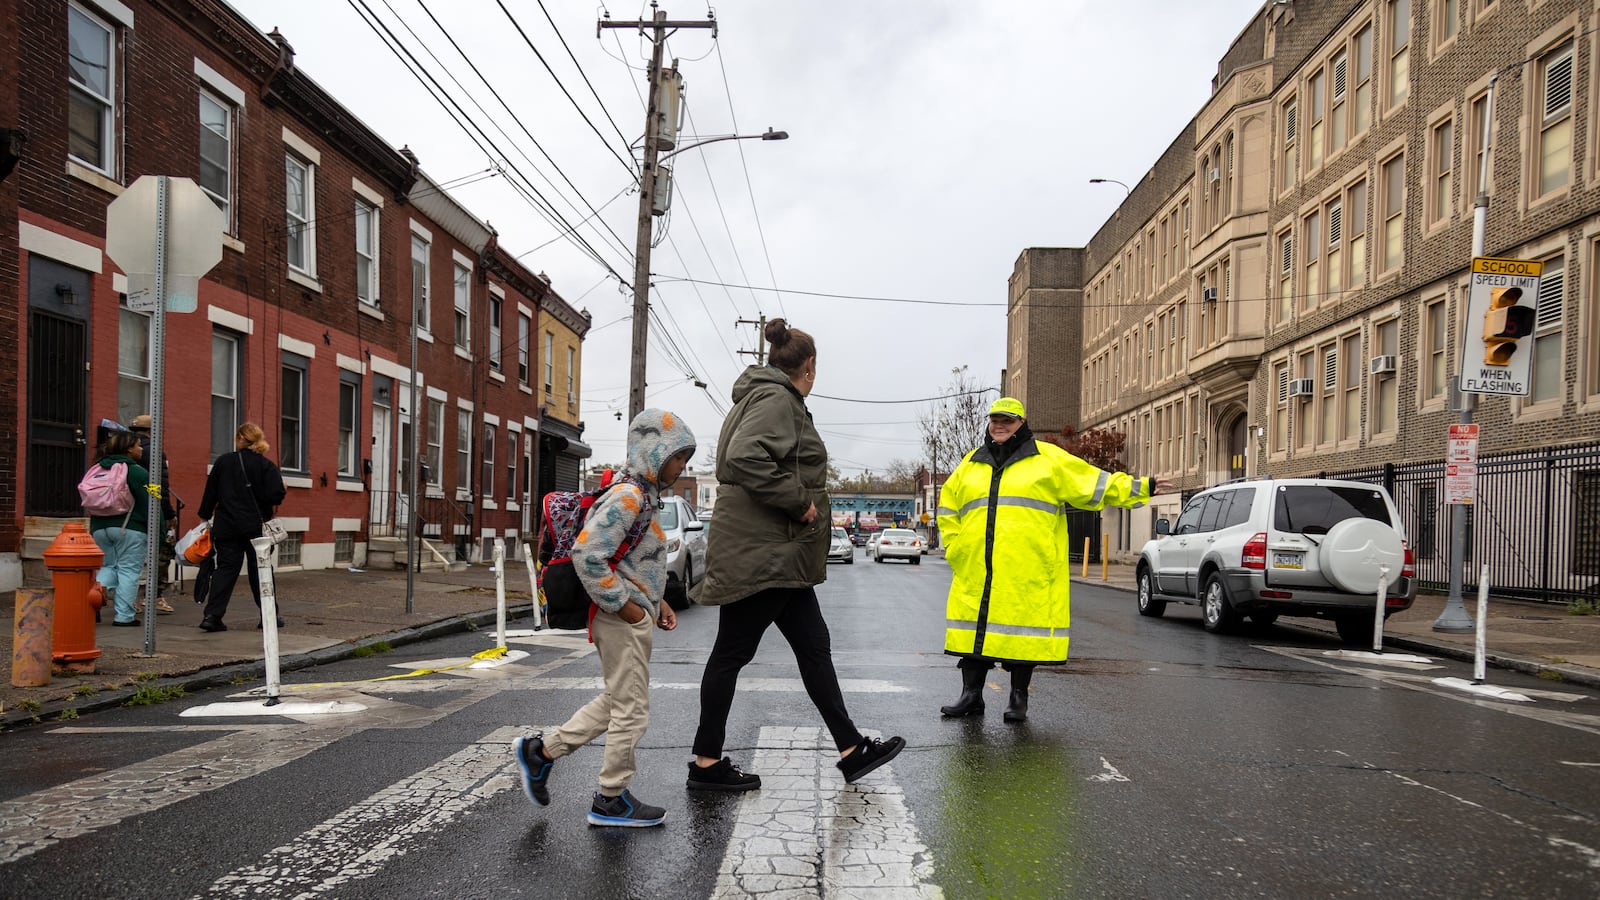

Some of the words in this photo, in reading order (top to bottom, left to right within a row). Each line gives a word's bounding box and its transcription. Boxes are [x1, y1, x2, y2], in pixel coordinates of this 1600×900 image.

[1481, 261, 1533, 275] SCHOOL
[1476, 275, 1507, 286] SPEED
[1510, 277, 1535, 288] LIMIT
[1480, 369, 1511, 380] WHEN
[1467, 379, 1522, 393] FLASHING
[1457, 425, 1470, 433] NO
